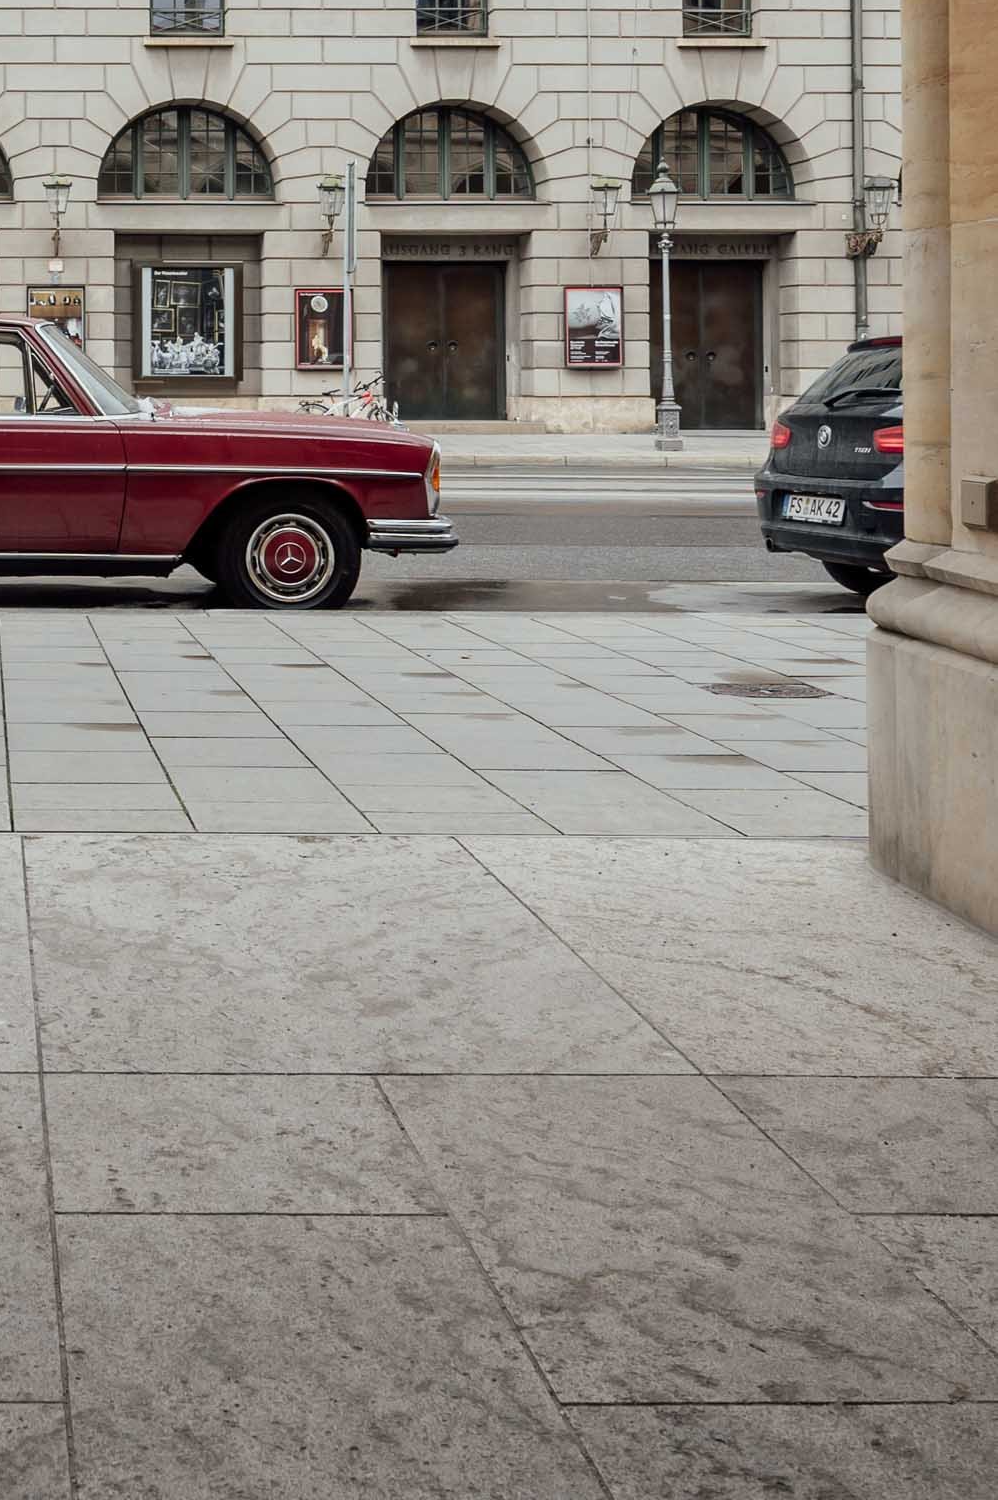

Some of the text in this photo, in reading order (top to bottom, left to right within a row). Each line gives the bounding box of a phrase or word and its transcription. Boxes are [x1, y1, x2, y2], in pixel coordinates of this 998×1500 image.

[473, 243, 514, 256] RANG
[789, 497, 841, 518] FS AK 42
